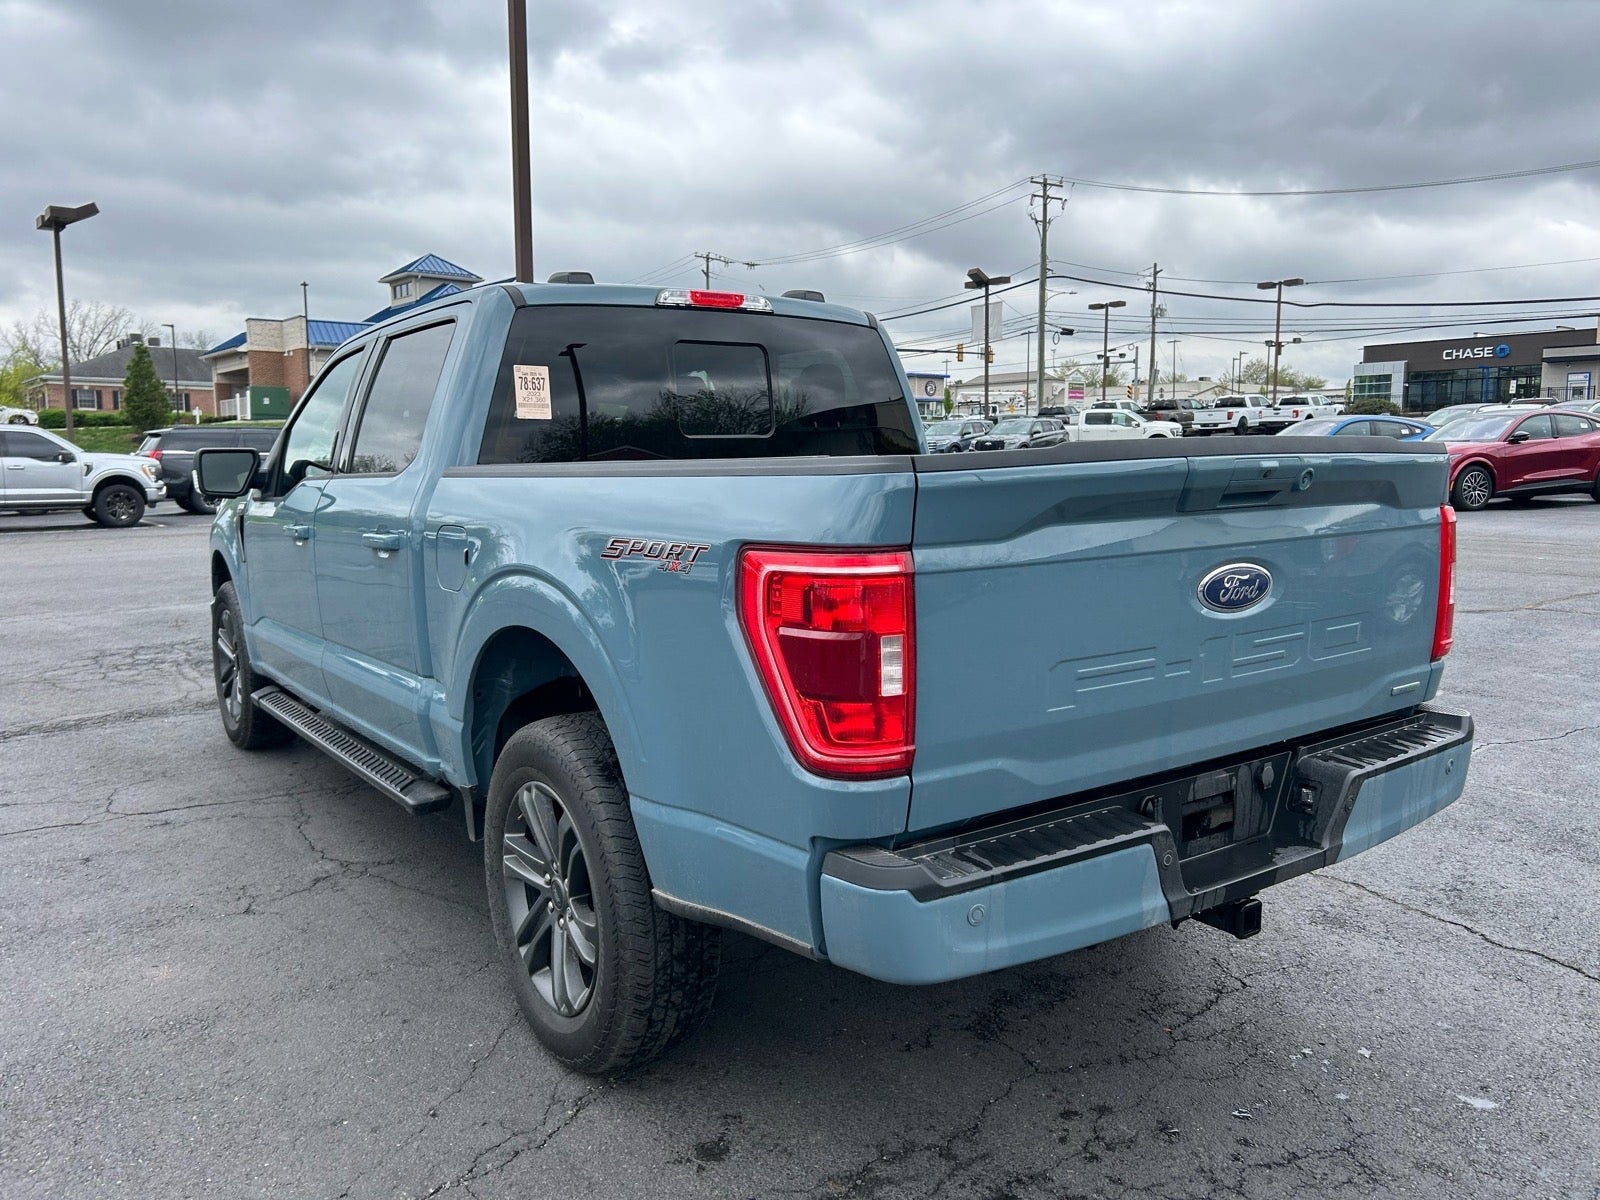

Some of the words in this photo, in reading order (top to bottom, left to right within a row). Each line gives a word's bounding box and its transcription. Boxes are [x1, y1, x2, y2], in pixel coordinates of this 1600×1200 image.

[1442, 346, 1494, 360] CHASE
[518, 376, 545, 391] 78:637
[600, 536, 711, 563] SPORT
[1220, 574, 1260, 602] Ford
[1047, 611, 1372, 712] F-150
